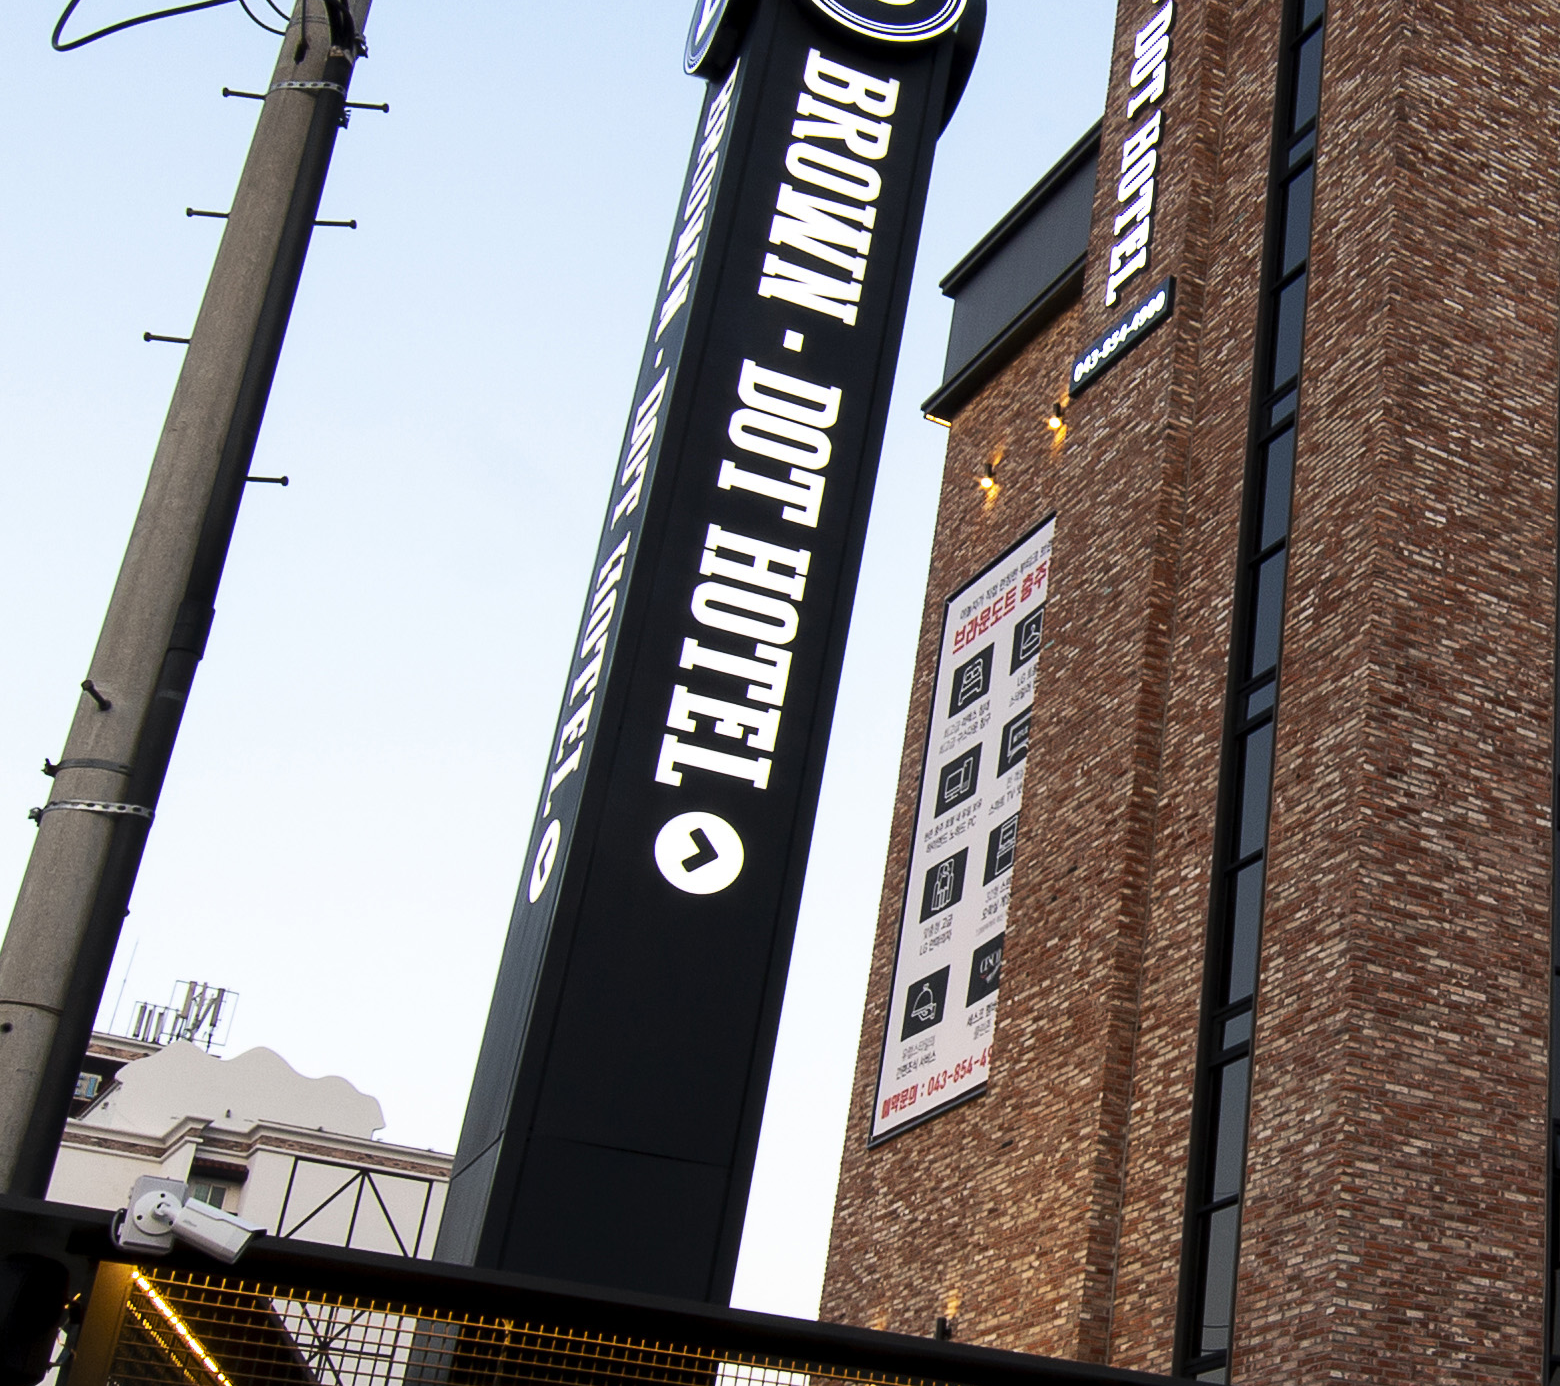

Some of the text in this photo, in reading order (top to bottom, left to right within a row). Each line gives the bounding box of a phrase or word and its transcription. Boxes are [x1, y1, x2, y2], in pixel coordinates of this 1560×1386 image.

[1127, 0, 1173, 120] DOT
[656, 56, 742, 345] BROWN
[758, 49, 900, 326] BROWN
[1105, 108, 1163, 307] HOTEL
[1074, 291, 1165, 382] 043-854-4900
[613, 366, 670, 544] DOT
[718, 359, 842, 528] DOT
[538, 539, 630, 818] HOTEL
[654, 522, 811, 790] HOTEL
[951, 556, 1050, 657] 브라운도트 충주
